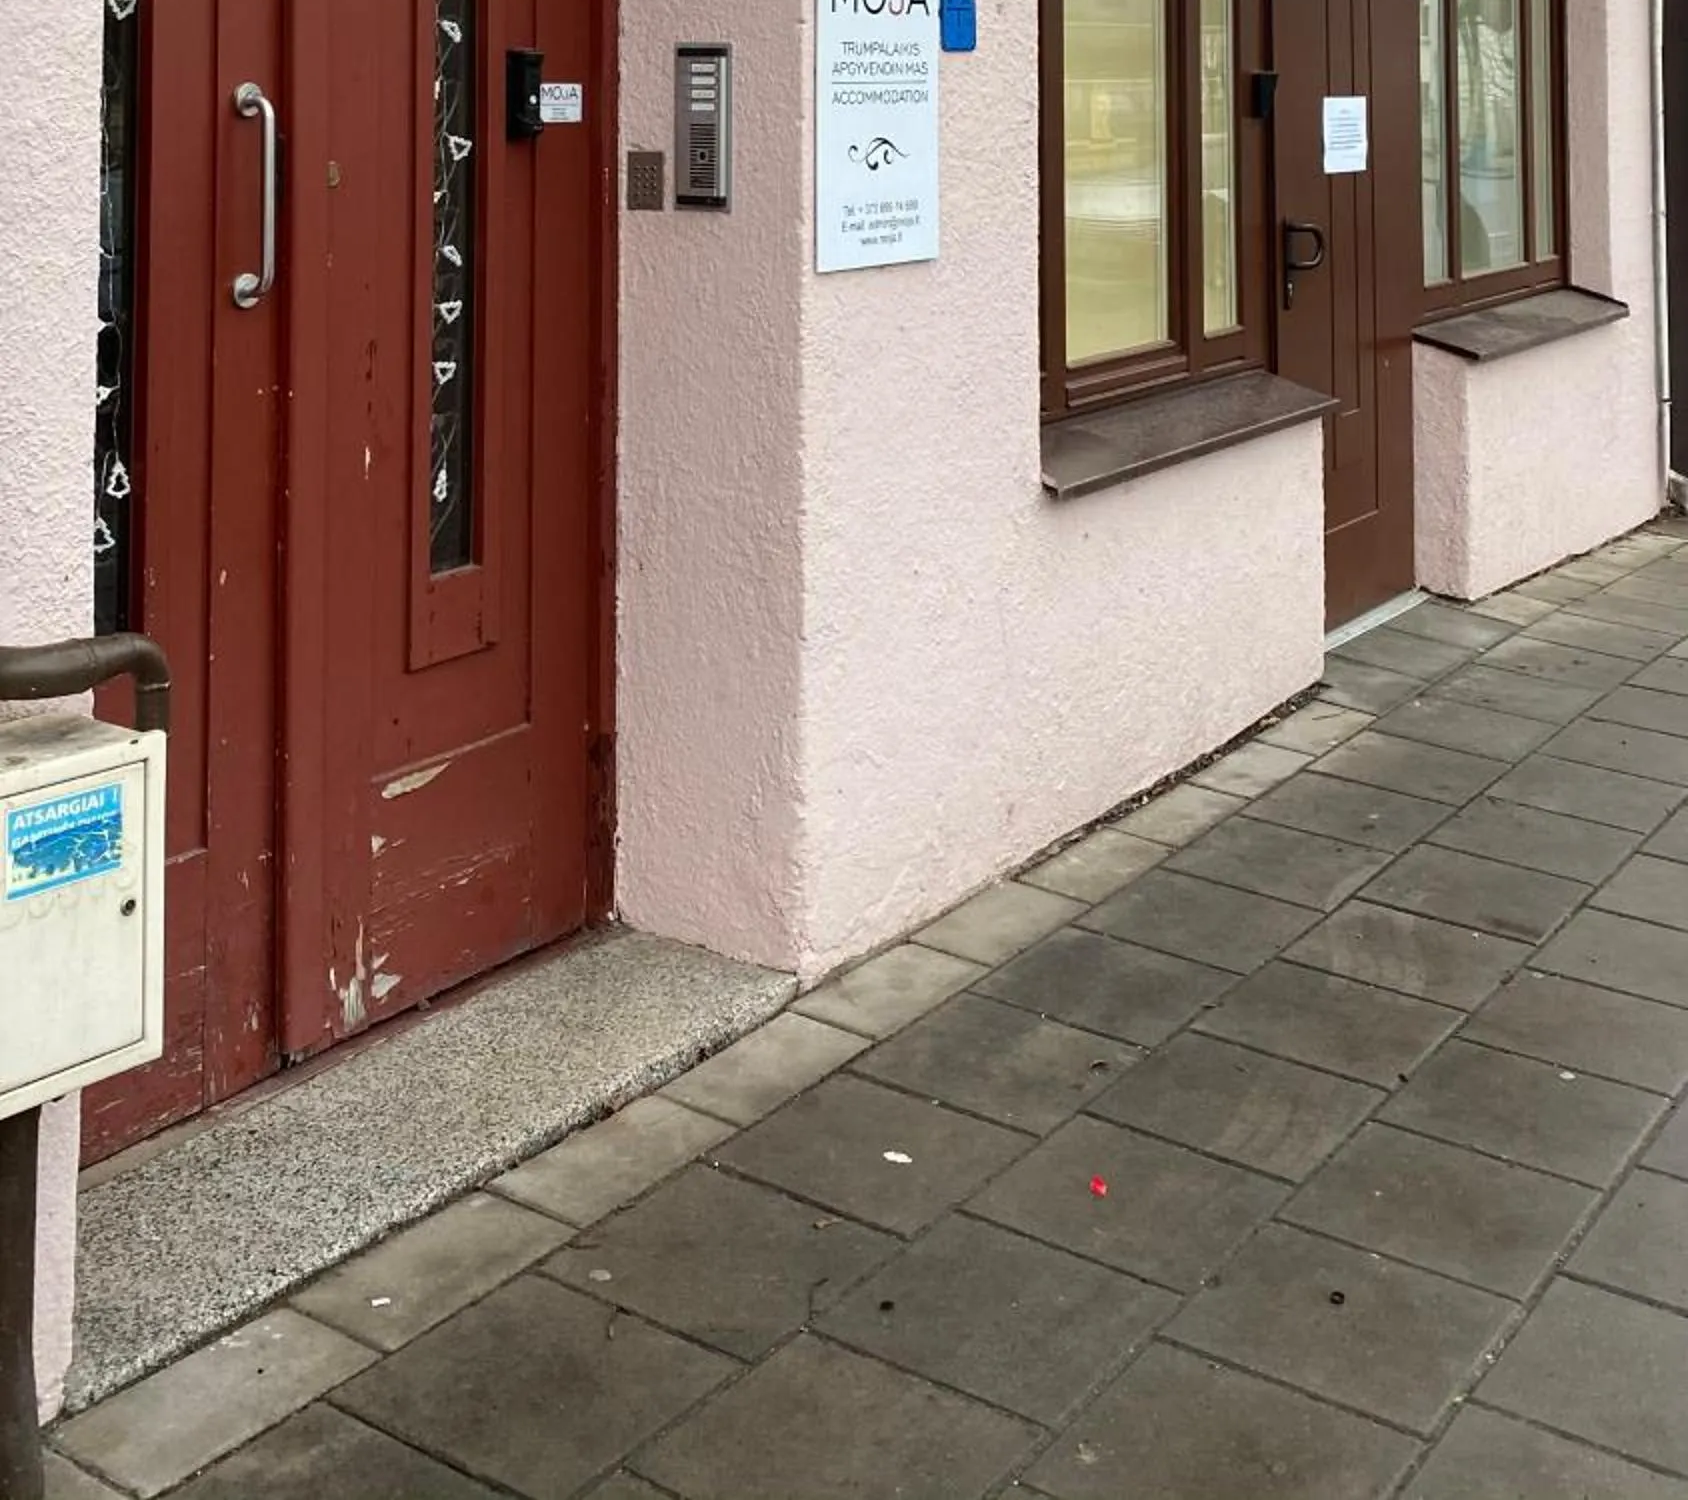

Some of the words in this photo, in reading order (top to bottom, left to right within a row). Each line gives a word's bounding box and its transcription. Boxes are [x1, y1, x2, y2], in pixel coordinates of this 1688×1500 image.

[841, 40, 921, 57] TRUMPALAIKIS
[832, 61, 929, 76] APGYVENDINIMAS
[832, 88, 929, 105] ACCOMMODATION
[14, 793, 105, 831] ATSARGIAI
